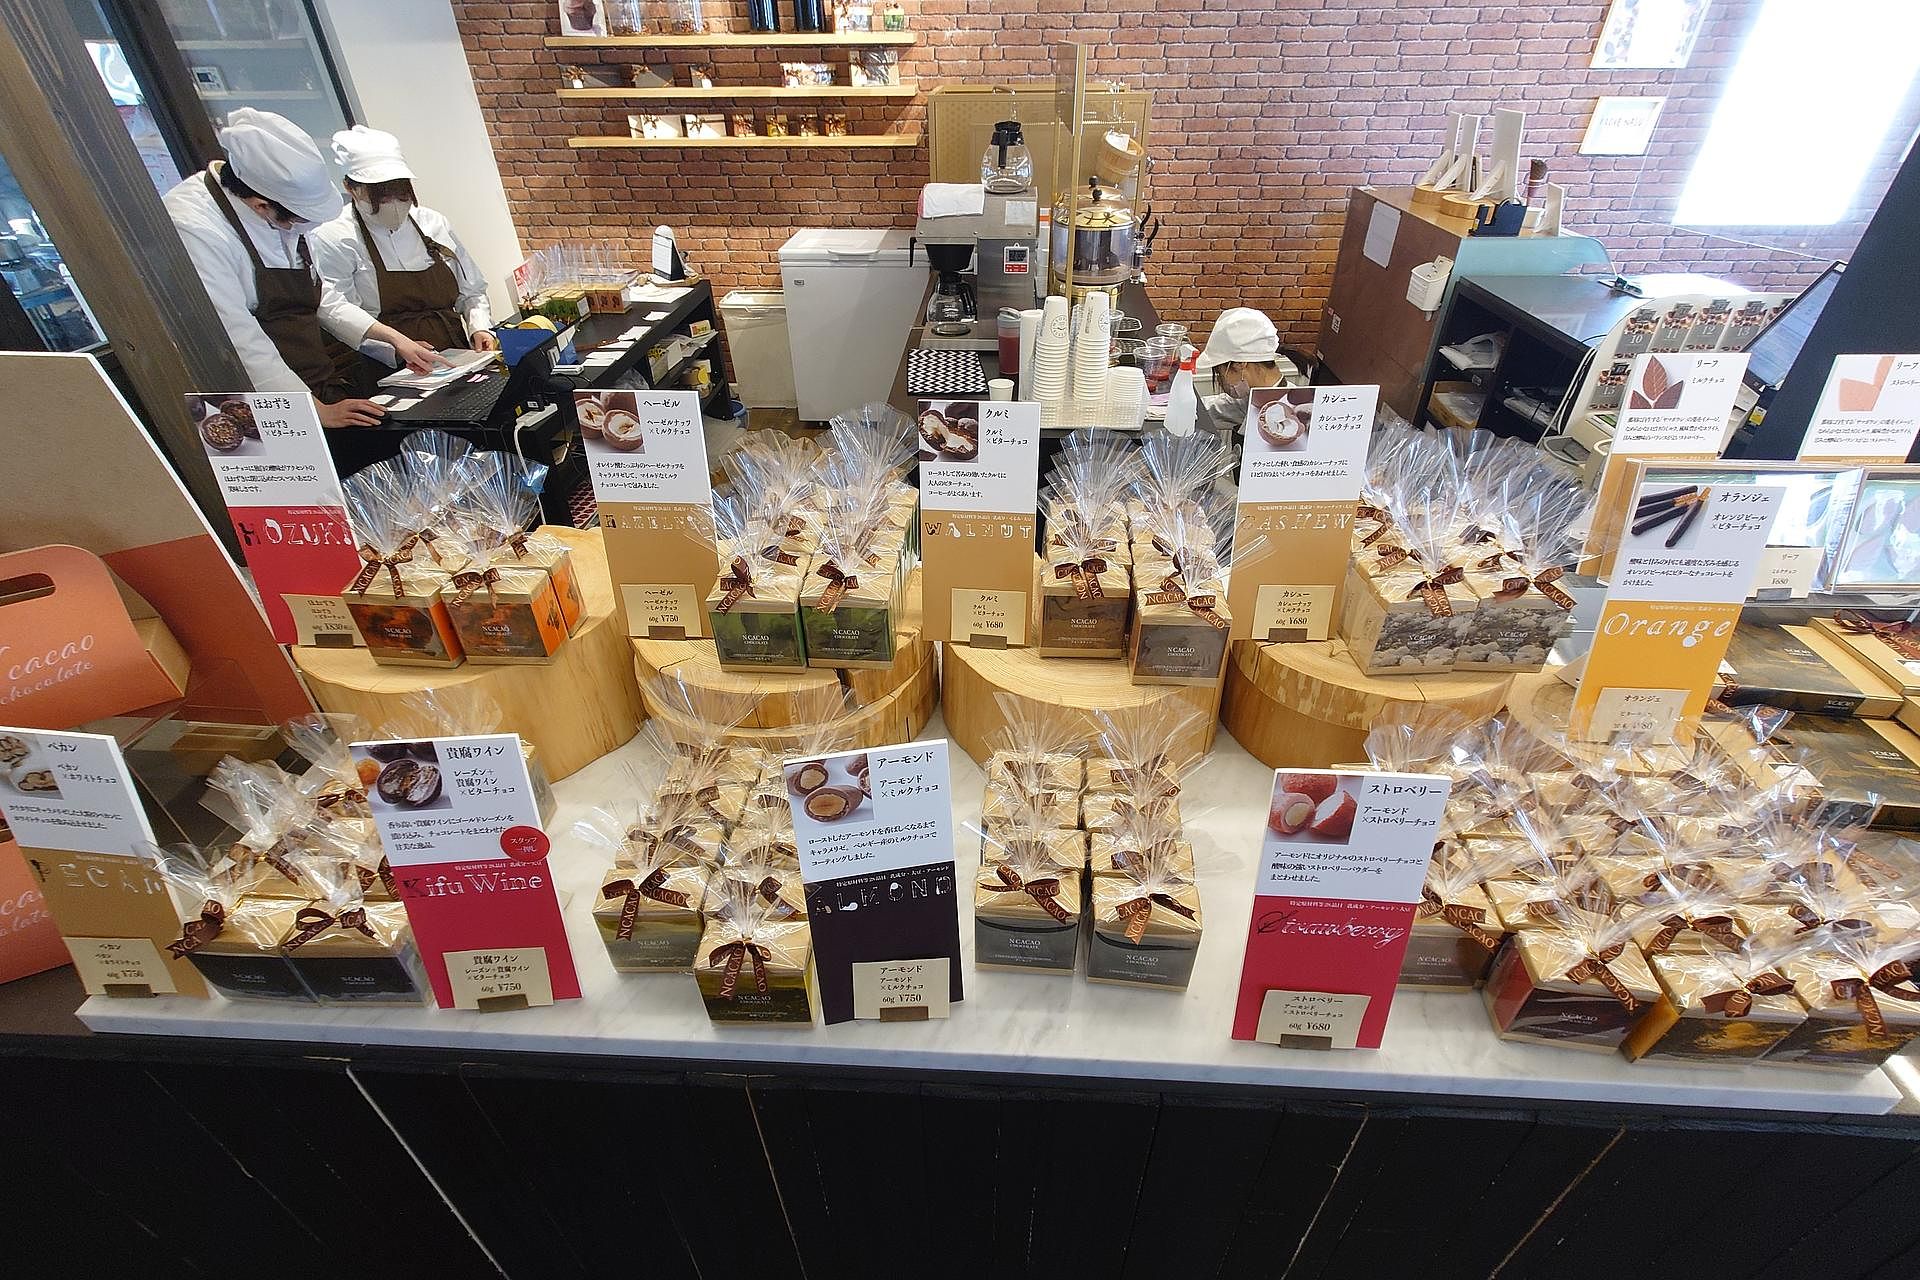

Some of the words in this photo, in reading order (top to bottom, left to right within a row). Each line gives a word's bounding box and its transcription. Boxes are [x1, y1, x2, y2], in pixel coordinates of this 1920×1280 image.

[1696, 359, 1719, 369] リーフ
[1896, 361, 1919, 370] リーフ
[1691, 376, 1726, 384] ミルクチョコ
[643, 398, 681, 409] ヘーゼル
[1321, 393, 1358, 405] カシュー
[253, 398, 291, 411] ほおずき
[985, 408, 1010, 419] クルミ
[646, 418, 692, 428] ヘーゼルナッツ
[1318, 414, 1364, 424] カシューナッツ
[261, 420, 288, 429] ほおずき
[1318, 423, 1362, 432] ×ミルクチョコ
[266, 429, 308, 438] ×ビターチョコ
[649, 428, 692, 436] ×ミルクチョコ
[985, 428, 1003, 437] クルミ
[986, 438, 1029, 446] ×ビターチョコ
[1720, 492, 1771, 503] オランジェ
[1711, 513, 1769, 522] オレンジピール
[1711, 523, 1762, 531] ×ビターチョコ
[980, 594, 998, 603] クルミ
[1281, 590, 1311, 599] カシュー
[660, 614, 679, 623] ¥750
[1288, 616, 1308, 626] ¥680
[985, 620, 1004, 629] ¥680
[832, 628, 860, 636] NCACAO
[1604, 612, 1733, 648] Orange
[8, 634, 95, 681] cacao
[47, 742, 78, 753] ペカン
[446, 745, 506, 760] 貴腐ワイン
[876, 750, 935, 769] アーモンド
[58, 763, 79, 772] ペカン
[456, 777, 499, 788] 貴腐ワイン
[879, 774, 924, 789] アーモンド
[461, 787, 516, 797] ×ビターチョコ
[881, 783, 940, 798] ×ミルクチョコ
[1367, 783, 1443, 797] ストロベリー
[1362, 805, 1410, 816] アーモンド
[1361, 815, 1437, 828] ×ストロベリーチョコ
[509, 836, 538, 846] スタッフ
[811, 853, 876, 867] コーティングしました。
[403, 875, 465, 899] Kifu
[464, 872, 544, 895] Wine
[815, 876, 952, 916] ALMOND
[1008, 938, 1042, 946] NCACAO
[473, 954, 520, 966] 貴腐ワイン
[1126, 953, 1159, 962] NCACAO
[880, 964, 923, 975] アーモンド
[880, 976, 913, 984] アーモンド
[497, 982, 522, 992] ¥750
[880, 983, 924, 991] ×ミルクチョコ
[882, 996, 896, 1004] 60g
[899, 993, 922, 1003] ¥750
[1291, 995, 1344, 1004] ストロベリー
[1284, 1003, 1317, 1011] アーモンド
[1288, 1022, 1302, 1031] 60g
[1306, 1021, 1331, 1032] ¥680
